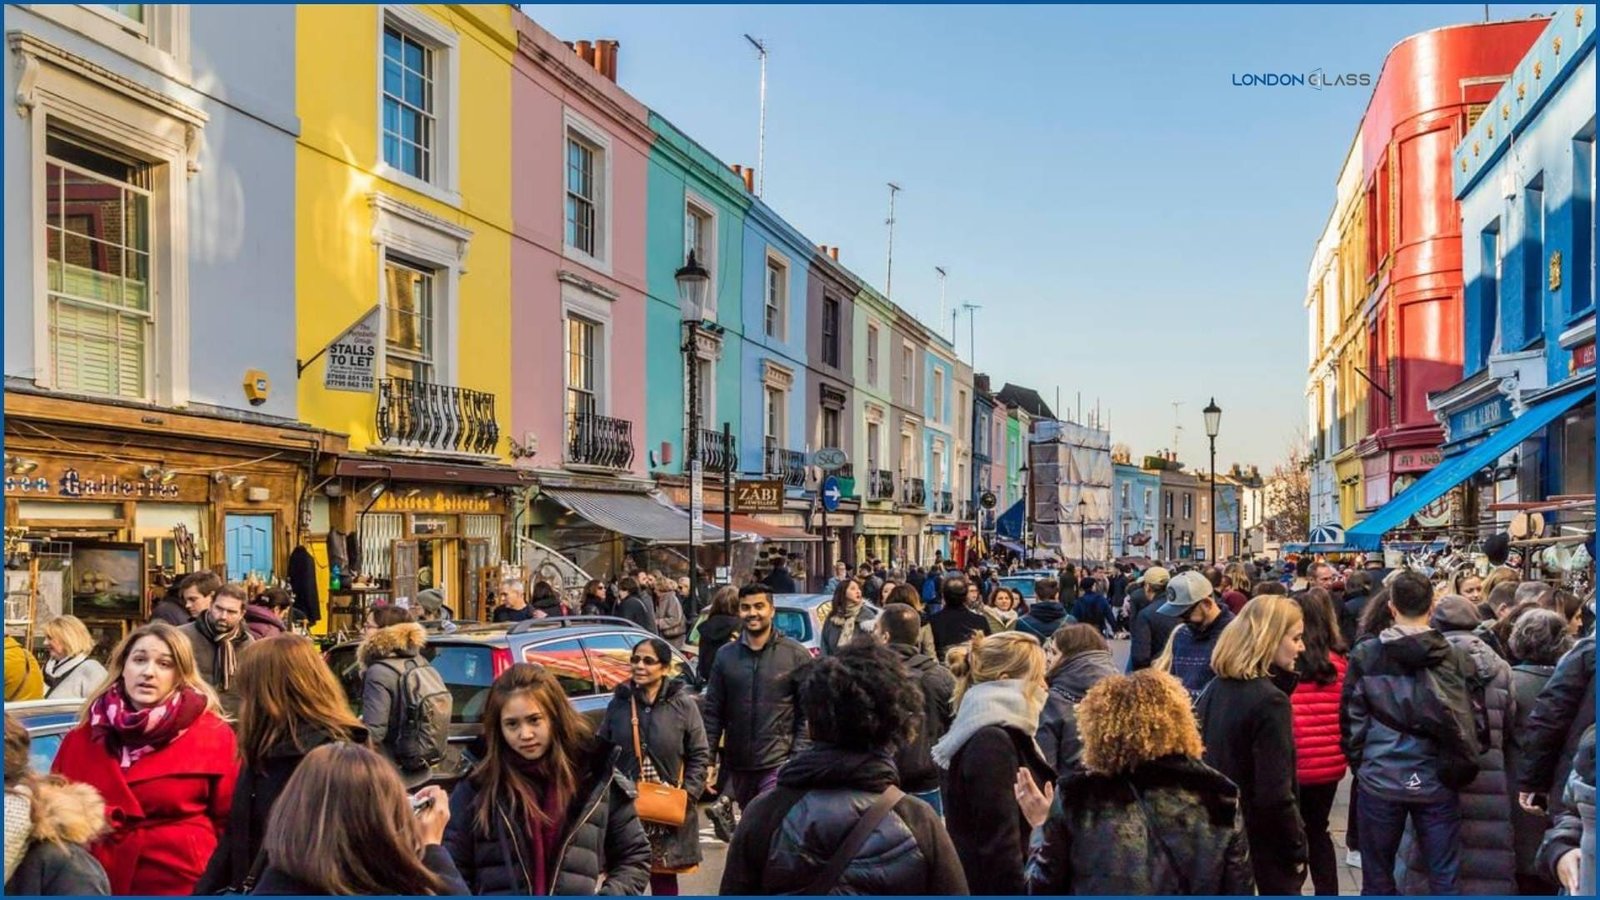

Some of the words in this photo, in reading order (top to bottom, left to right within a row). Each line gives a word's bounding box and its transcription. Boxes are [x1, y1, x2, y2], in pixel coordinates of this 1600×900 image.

[330, 344, 375, 356] STALLS
[330, 355, 347, 365] TO
[350, 356, 373, 367] LET
[59, 465, 179, 498] Galleries
[738, 488, 777, 500] ZABI
